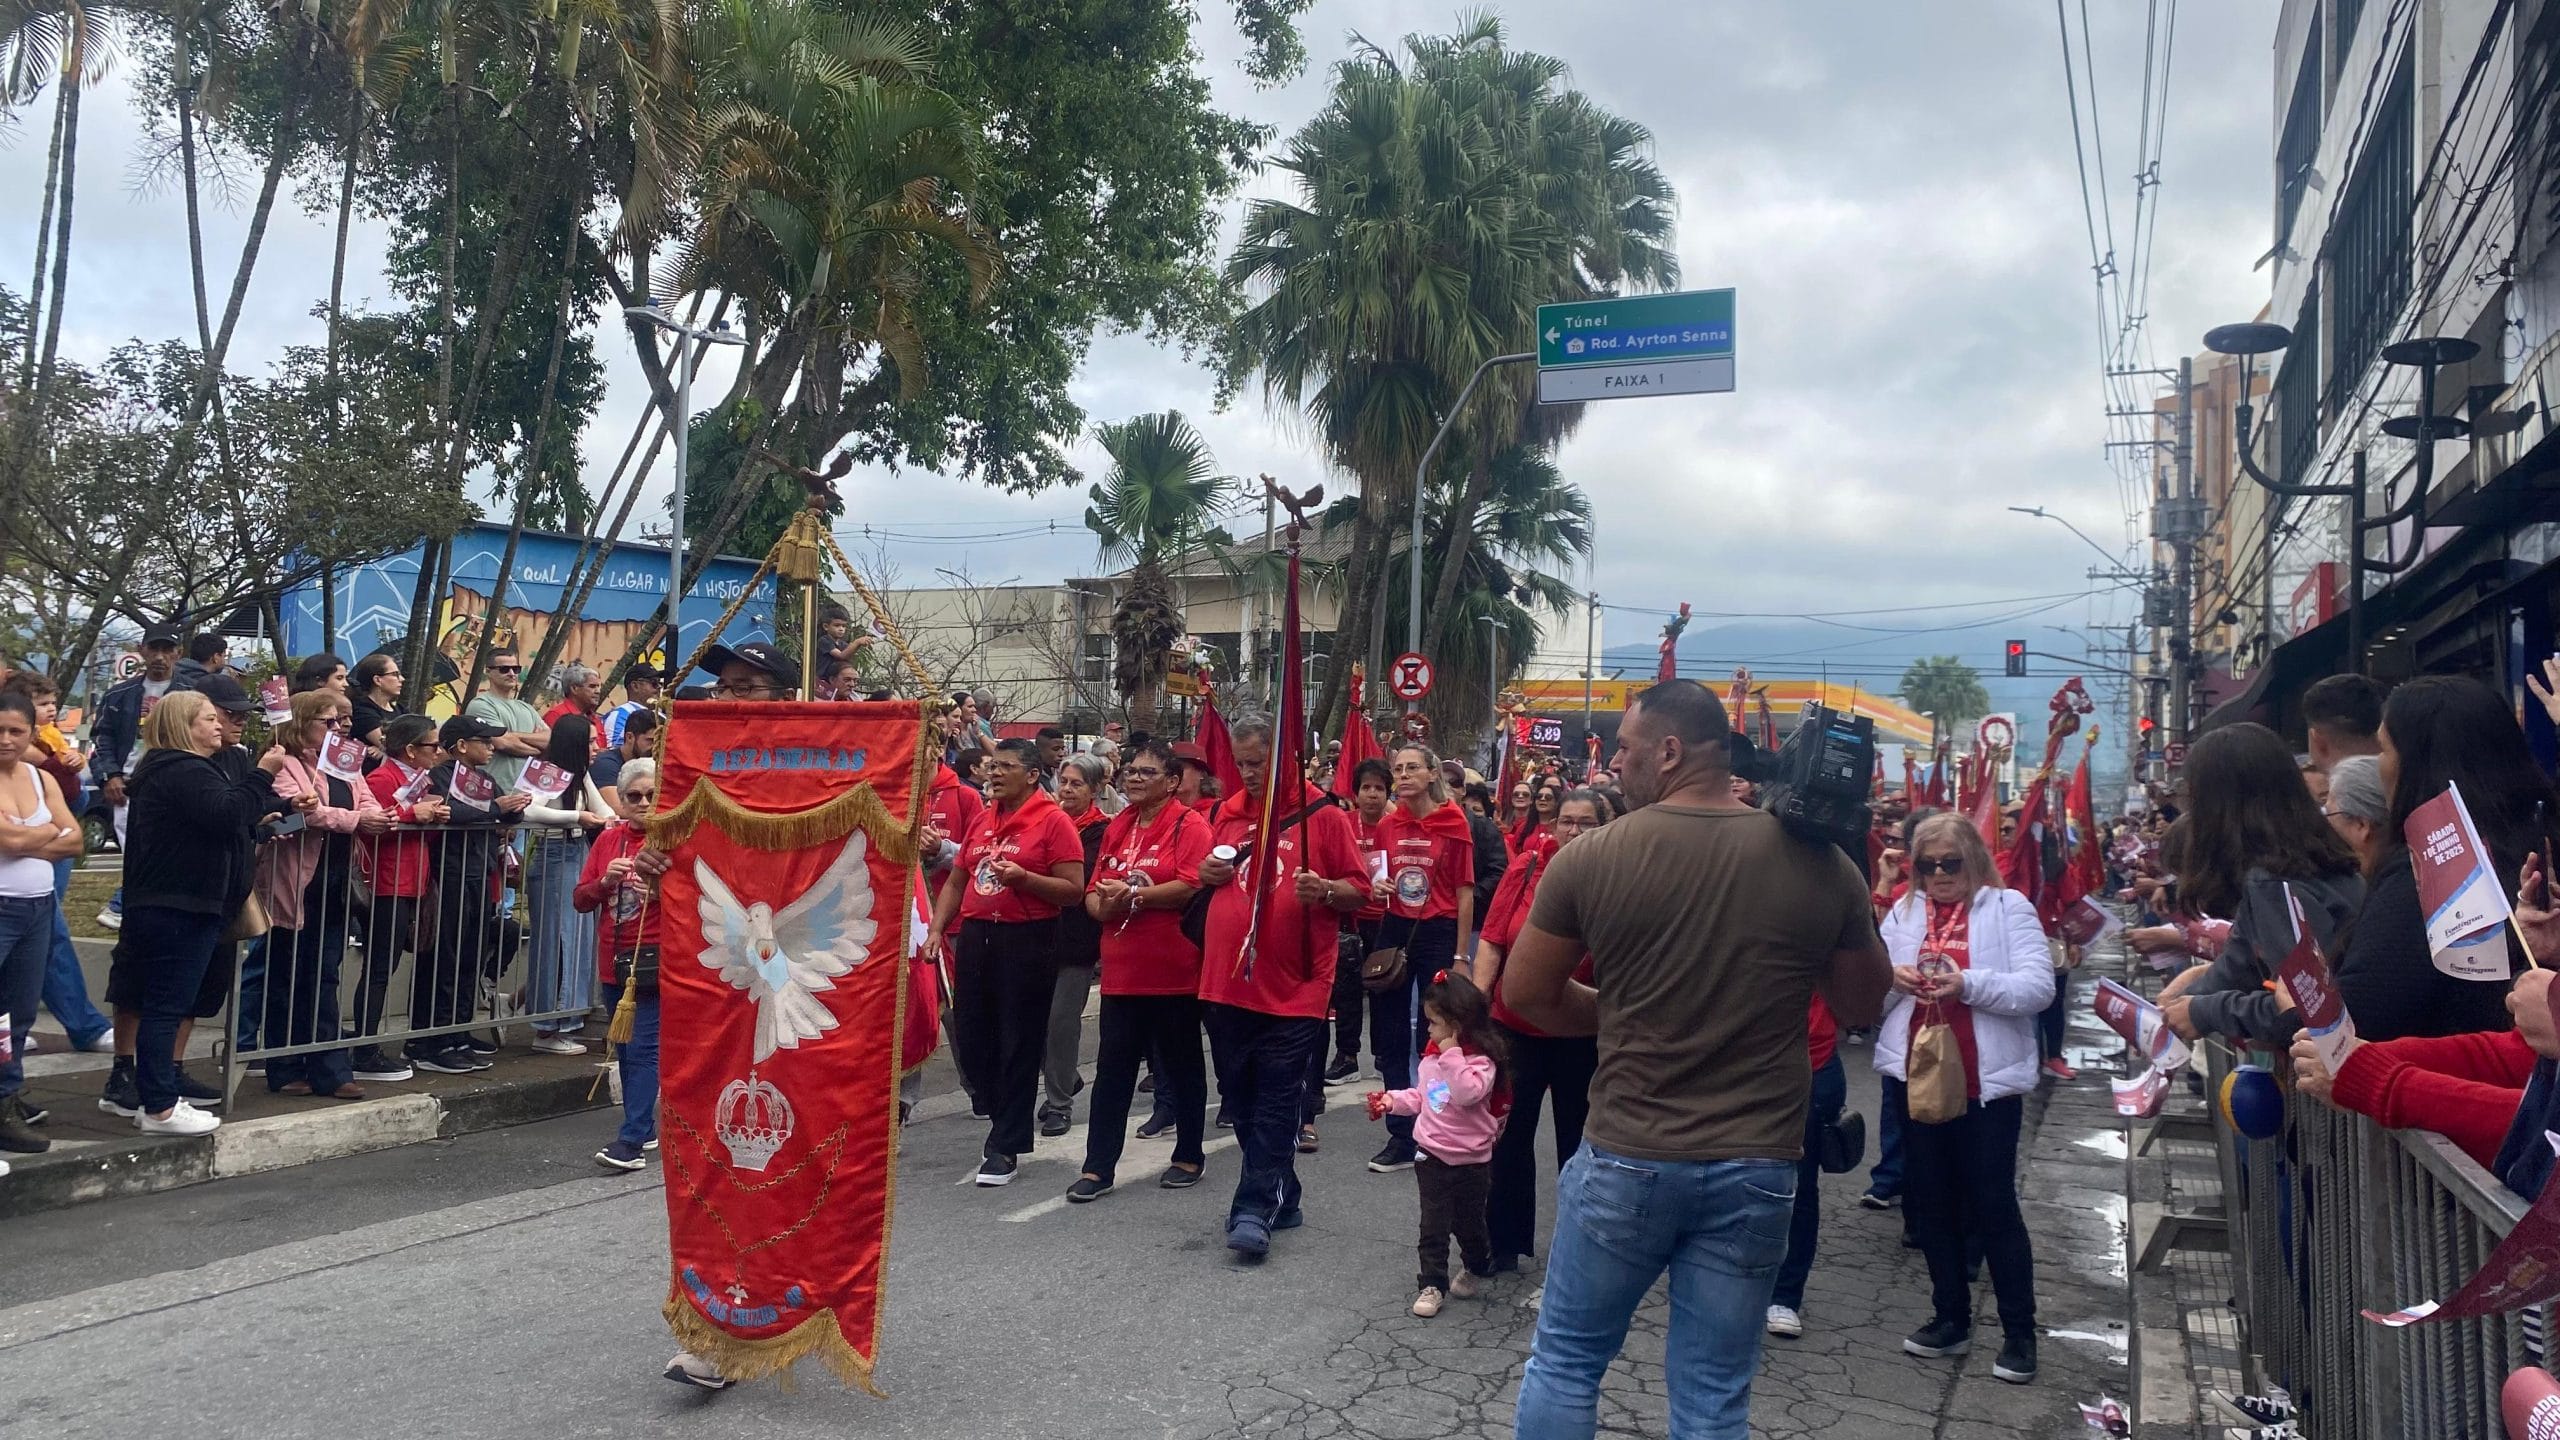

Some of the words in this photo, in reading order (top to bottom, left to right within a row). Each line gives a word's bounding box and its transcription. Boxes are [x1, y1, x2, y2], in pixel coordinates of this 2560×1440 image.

[1565, 315, 1608, 329] Túnel
[1591, 337, 1621, 350] Rod.
[1626, 333, 1677, 348] Ayrton
[1682, 329, 1728, 342] Senna
[1605, 375, 1649, 388] FAIXA
[1659, 373, 1664, 384] 1
[1533, 725, 1561, 742] 5,89
[2427, 822, 2456, 845] SÁBADO
[2426, 845, 2438, 858] DE
[2435, 833, 2460, 852] JUNHO
[2434, 852, 2446, 865] DE
[2444, 843, 2465, 860] 2025
